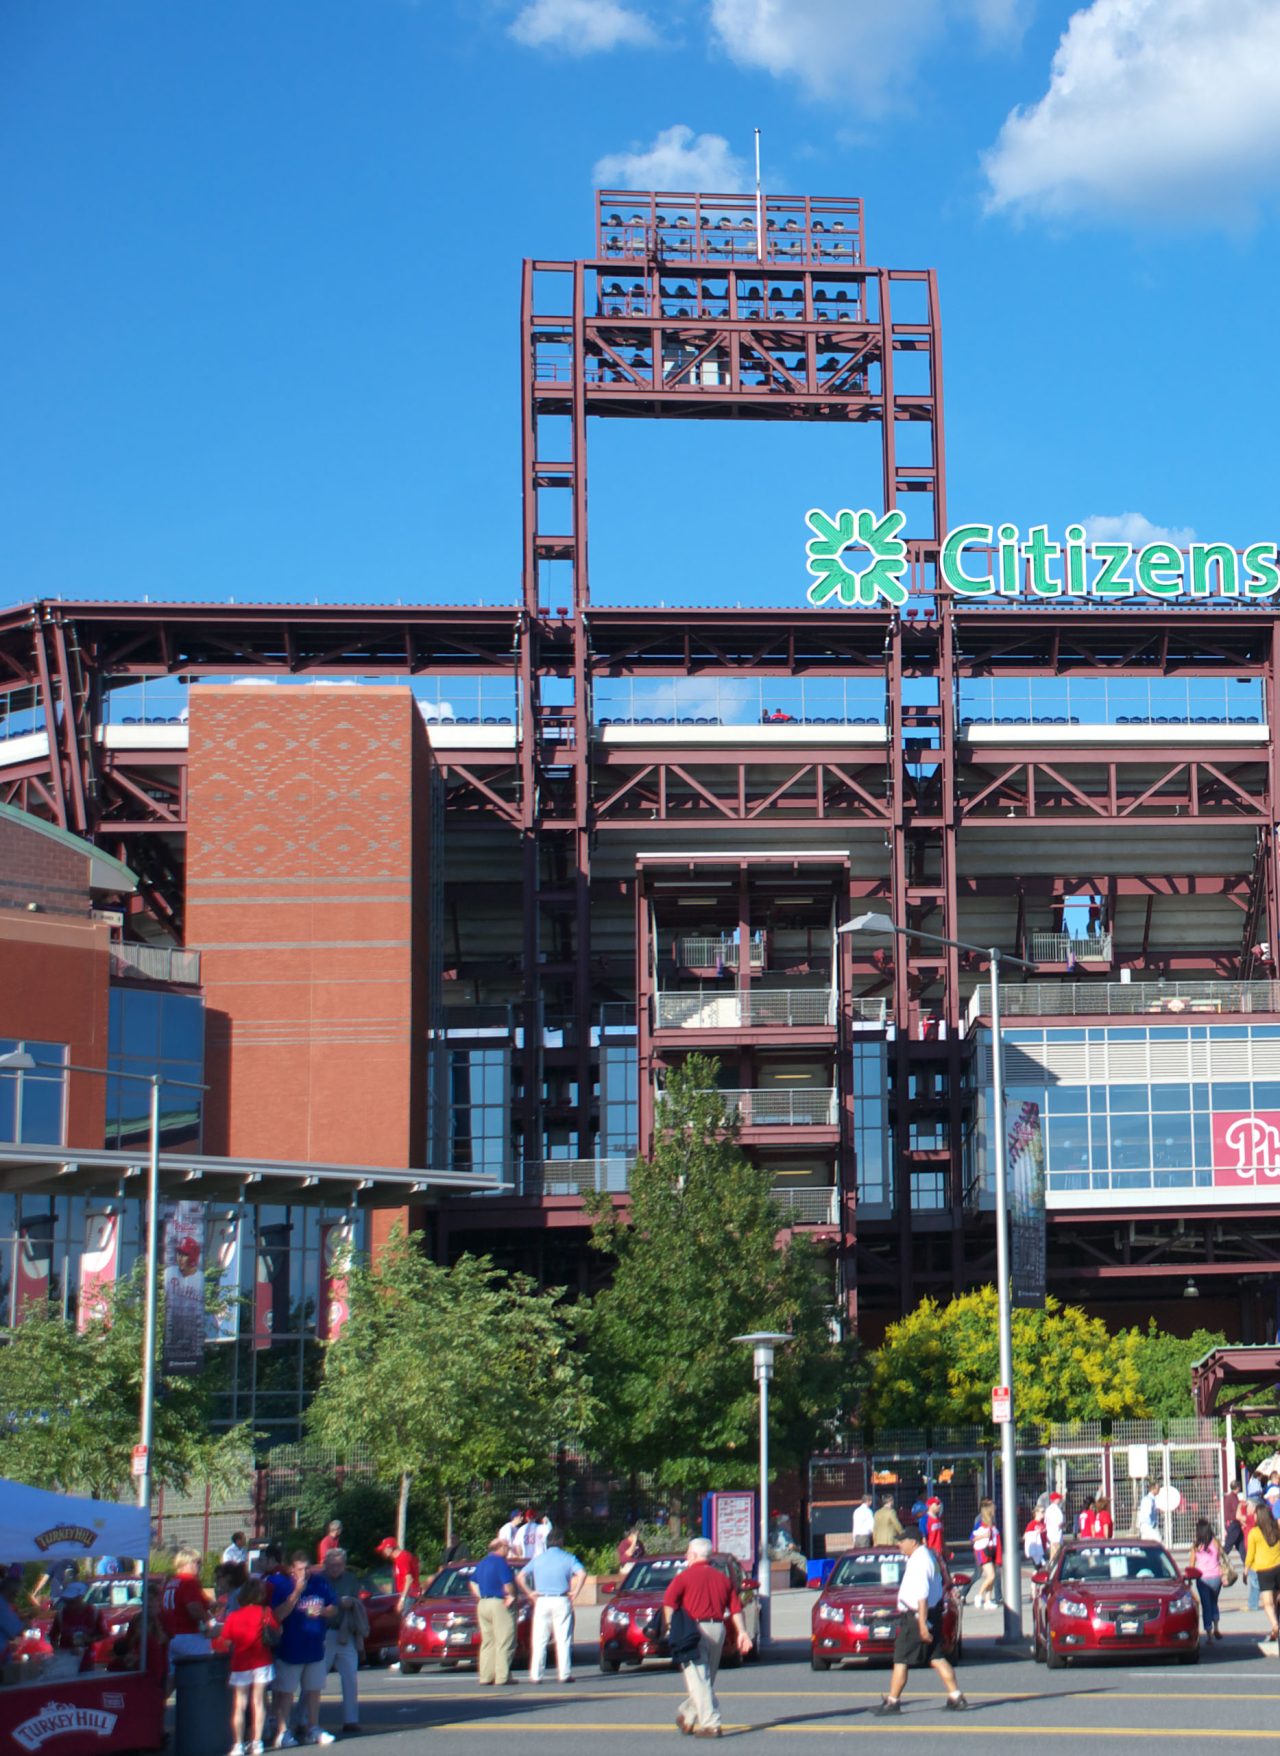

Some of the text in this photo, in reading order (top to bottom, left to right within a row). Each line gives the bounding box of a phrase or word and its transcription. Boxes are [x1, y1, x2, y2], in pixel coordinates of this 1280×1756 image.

[37, 1527, 94, 1547] TURKEY HILL
[1081, 1547, 1141, 1556] 42 MPG
[855, 1555, 875, 1563] 42
[17, 1710, 108, 1742] TURKEY HILL
